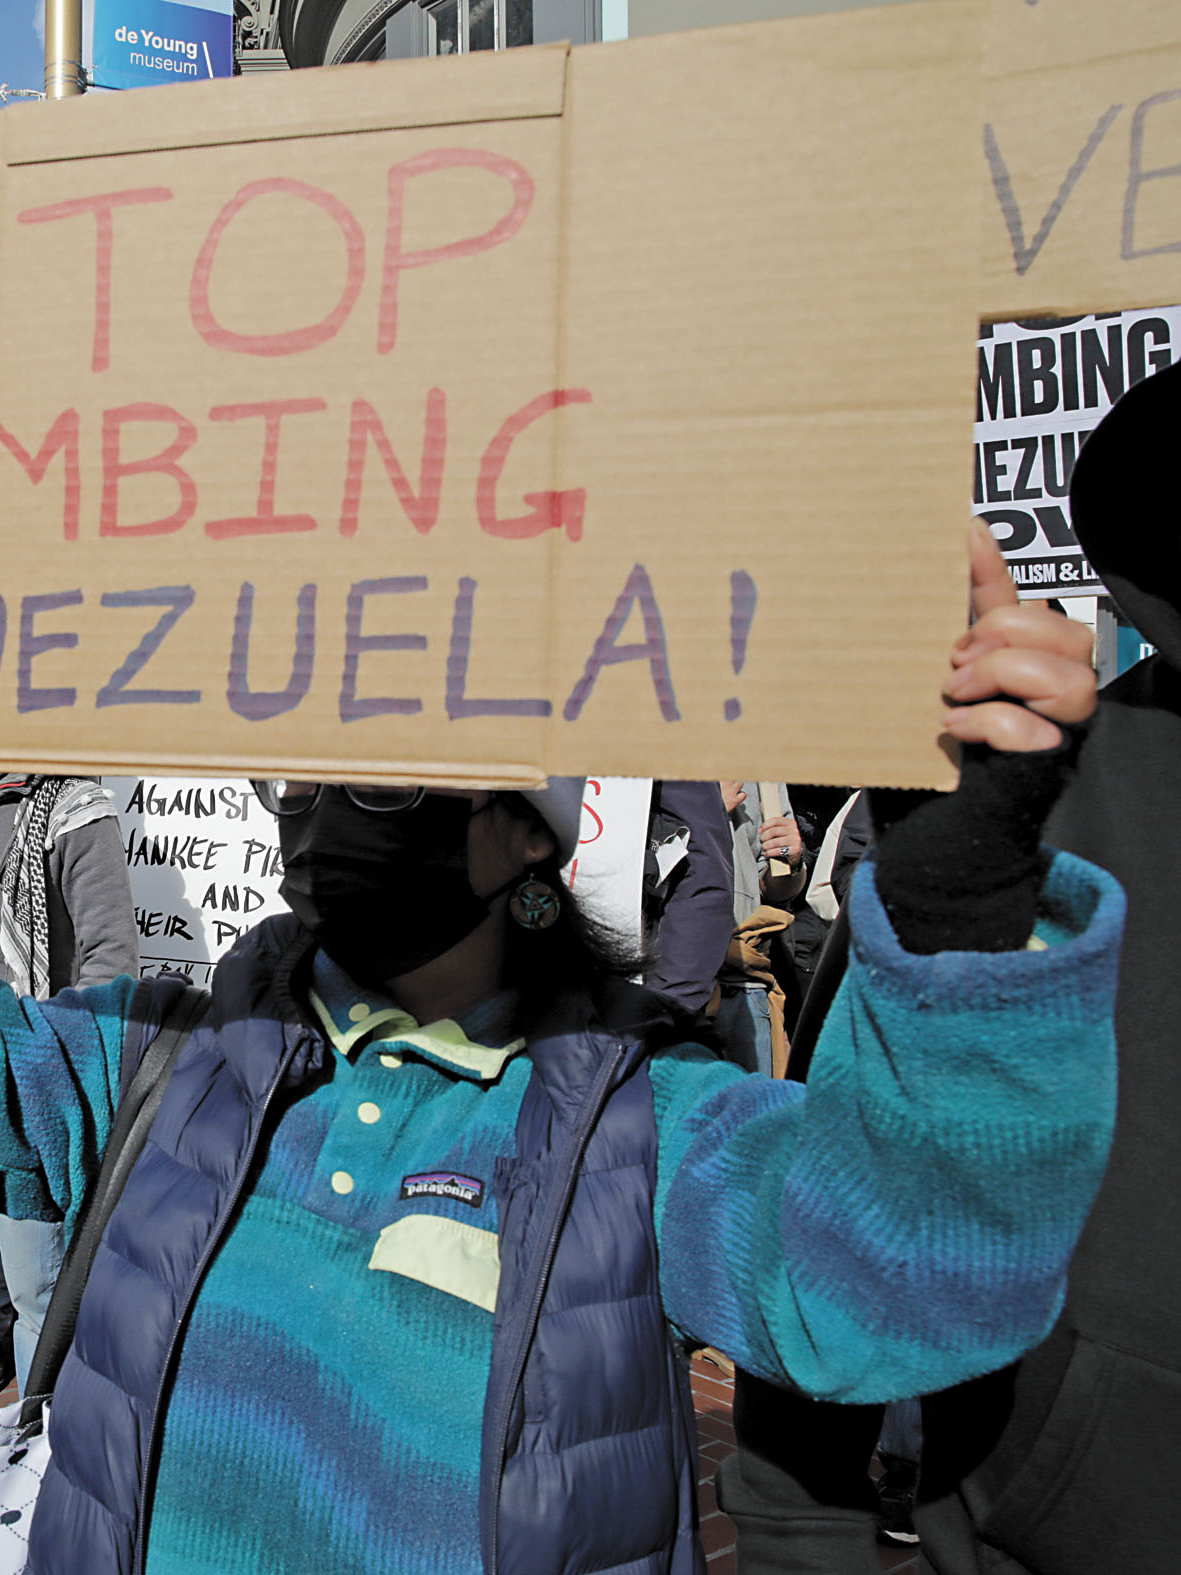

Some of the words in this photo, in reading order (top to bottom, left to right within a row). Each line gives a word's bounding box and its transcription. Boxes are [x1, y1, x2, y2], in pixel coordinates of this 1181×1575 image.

[115, 26, 138, 44] de
[140, 29, 198, 60] Young
[130, 52, 198, 76] museum
[983, 88, 1181, 277] VE
[976, 317, 1172, 423] MBING
[1012, 563, 1056, 584] ALISM
[1059, 563, 1080, 581] &
[125, 779, 256, 821] AGAINST
[242, 838, 285, 878] PIR
[201, 882, 265, 914] AND
[134, 906, 194, 941] HEIR
[407, 1183, 472, 1200] patagonia
